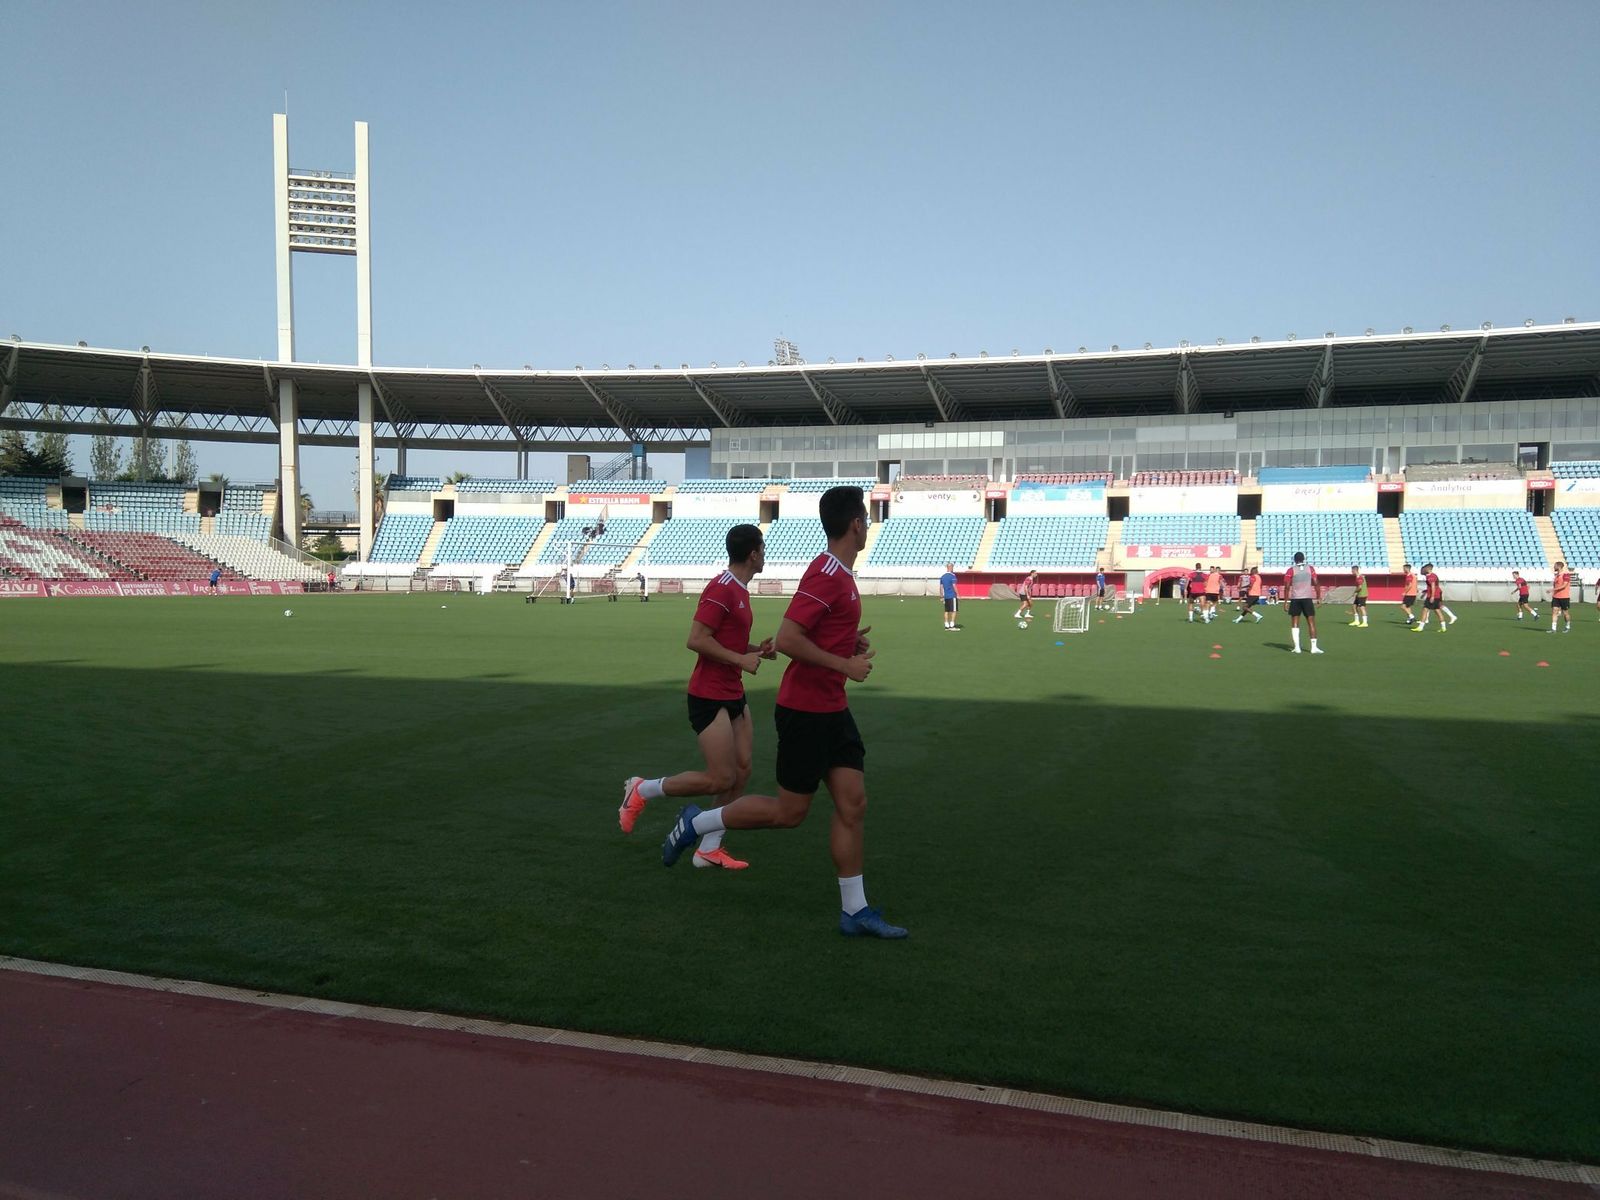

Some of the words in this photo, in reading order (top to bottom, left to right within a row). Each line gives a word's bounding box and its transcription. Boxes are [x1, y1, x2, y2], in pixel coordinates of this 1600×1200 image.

[927, 493, 952, 501] venty
[64, 584, 118, 596] CaixaBank
[123, 588, 168, 596] PLAYCAR
